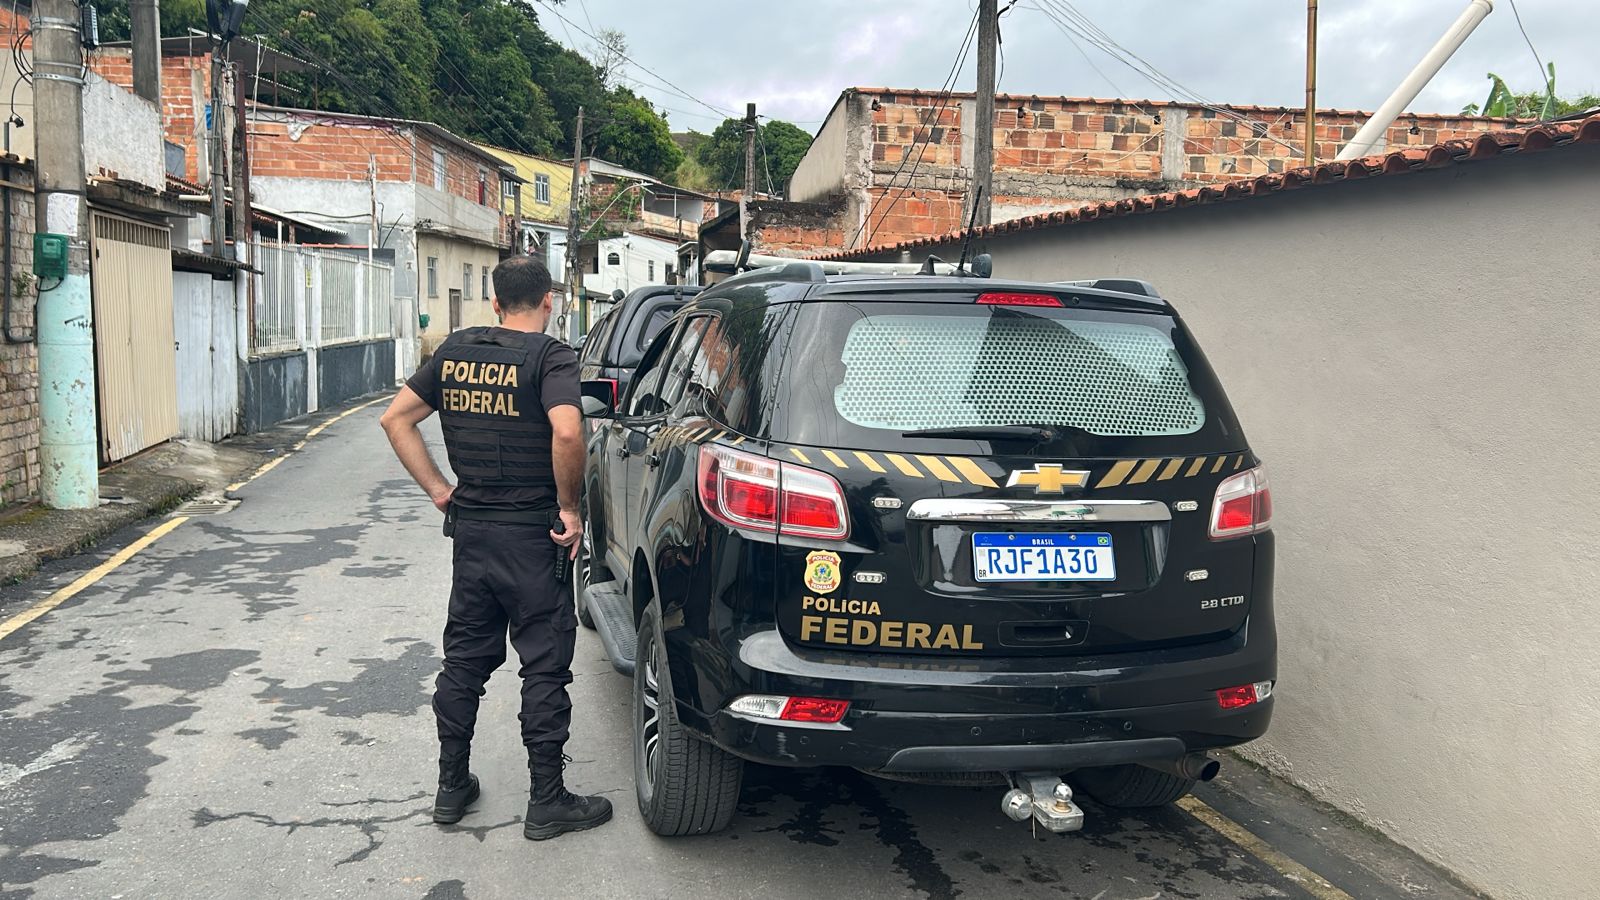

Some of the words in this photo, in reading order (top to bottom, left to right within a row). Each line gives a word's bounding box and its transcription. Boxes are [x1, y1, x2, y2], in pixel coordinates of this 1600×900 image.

[442, 388, 520, 417] FEDERAL
[1031, 538, 1055, 546] BRASIL
[987, 548, 1098, 574] RJF1A30
[978, 569, 987, 578] BR
[1220, 595, 1244, 607] CTDI
[800, 615, 984, 650] FEDERAL
